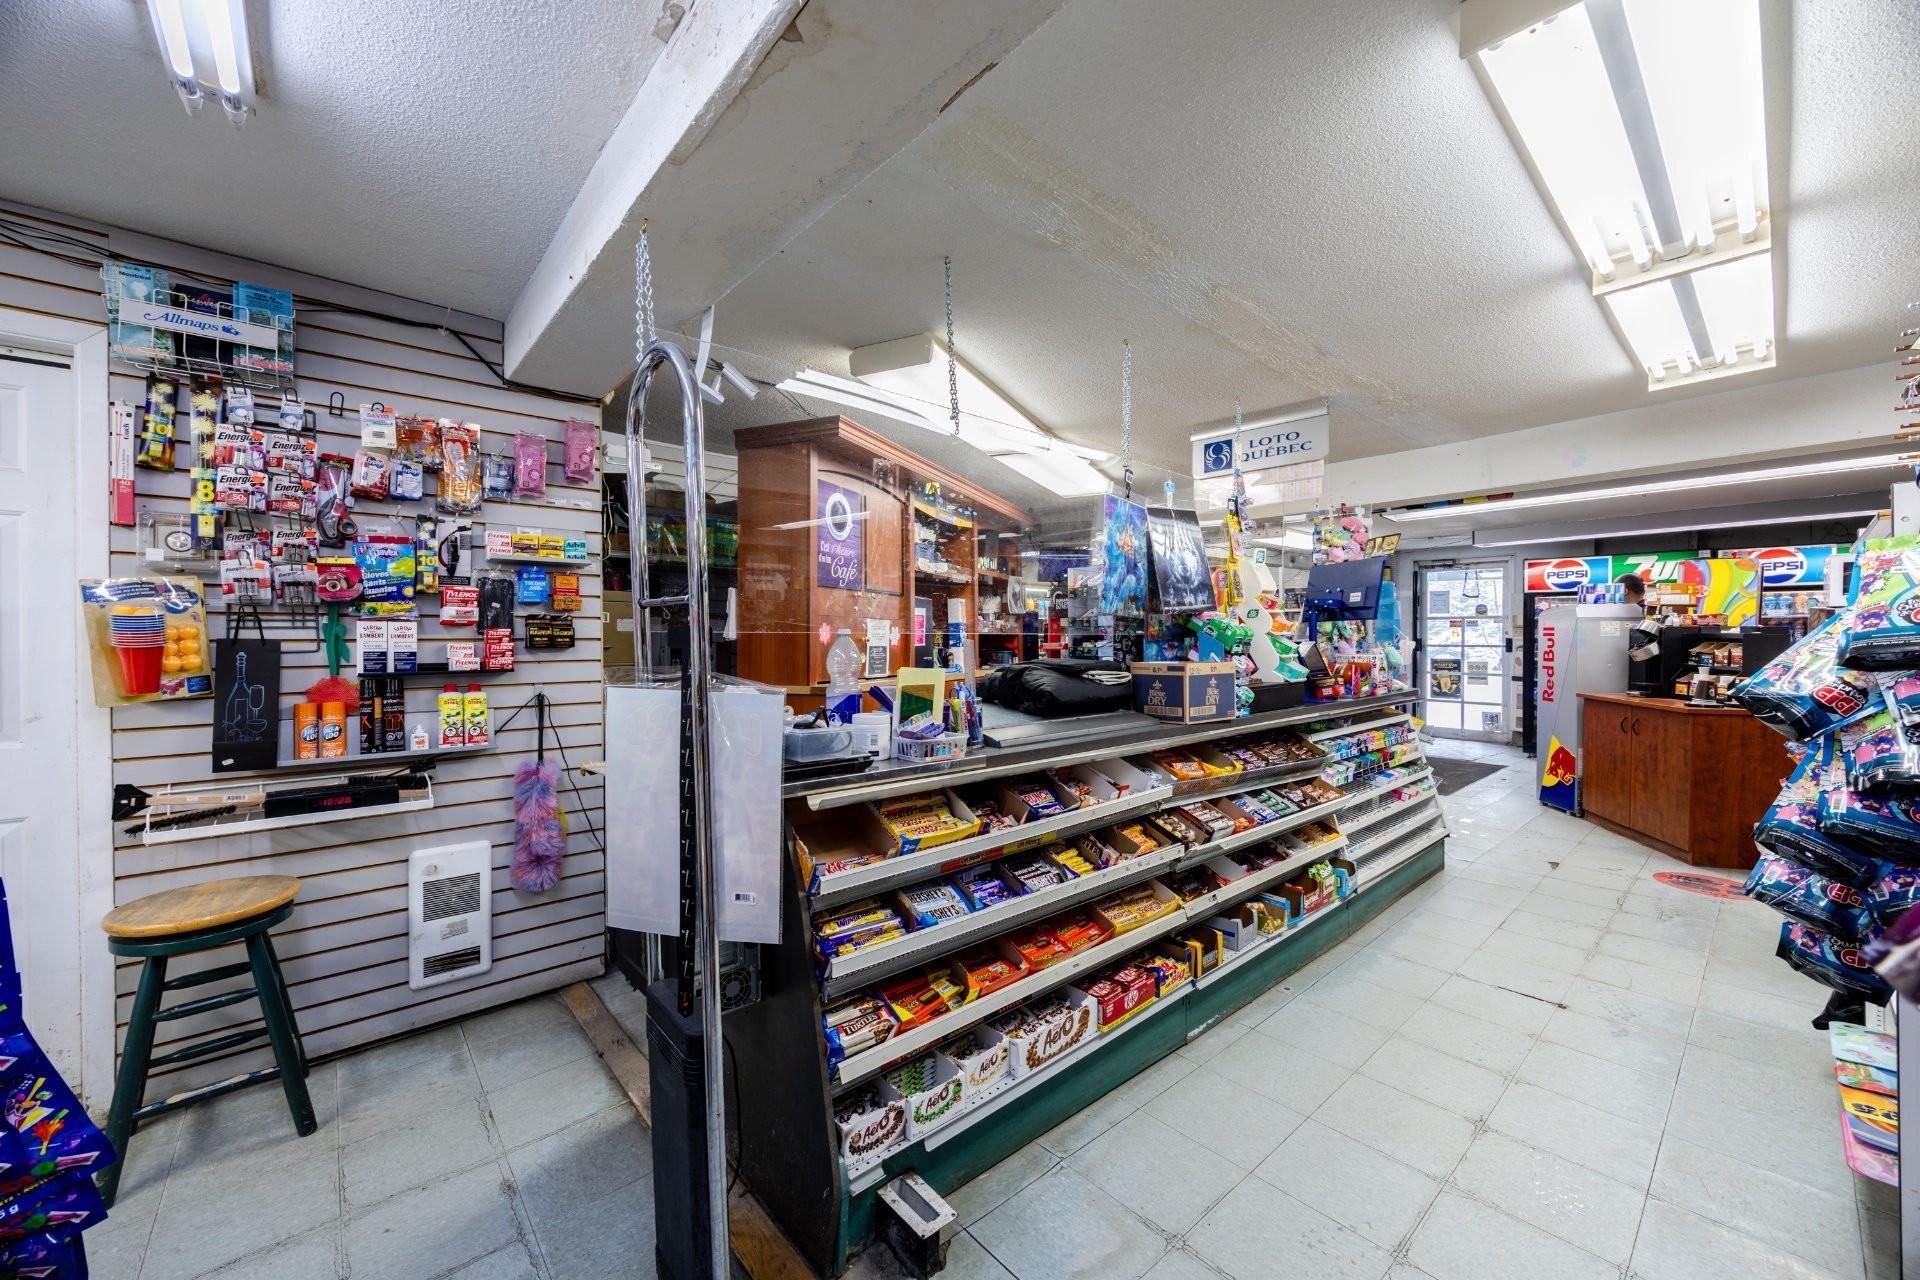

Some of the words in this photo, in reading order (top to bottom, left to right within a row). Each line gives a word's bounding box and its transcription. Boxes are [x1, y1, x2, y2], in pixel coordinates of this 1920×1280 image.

[144, 312, 219, 332] Allmaps
[1249, 431, 1301, 449] LOTO
[1240, 440, 1313, 462] QUÉBEC
[831, 556, 858, 587] Café
[1546, 569, 1589, 580] PEPSI
[1763, 561, 1804, 571] EPSI
[362, 572, 390, 580] Gloves
[363, 579, 387, 588] Gants
[364, 586, 398, 596] Guantes
[446, 590, 479, 599] TYLENOL
[1543, 627, 1555, 663] Bull
[1542, 665, 1555, 702] Red
[1148, 696, 1167, 706] DRY
[1206, 695, 1220, 706] DRY
[907, 887, 947, 904] HERSHEY'S
[836, 910, 879, 927] WUNDERBAR
[843, 1011, 880, 1035] TURTLES
